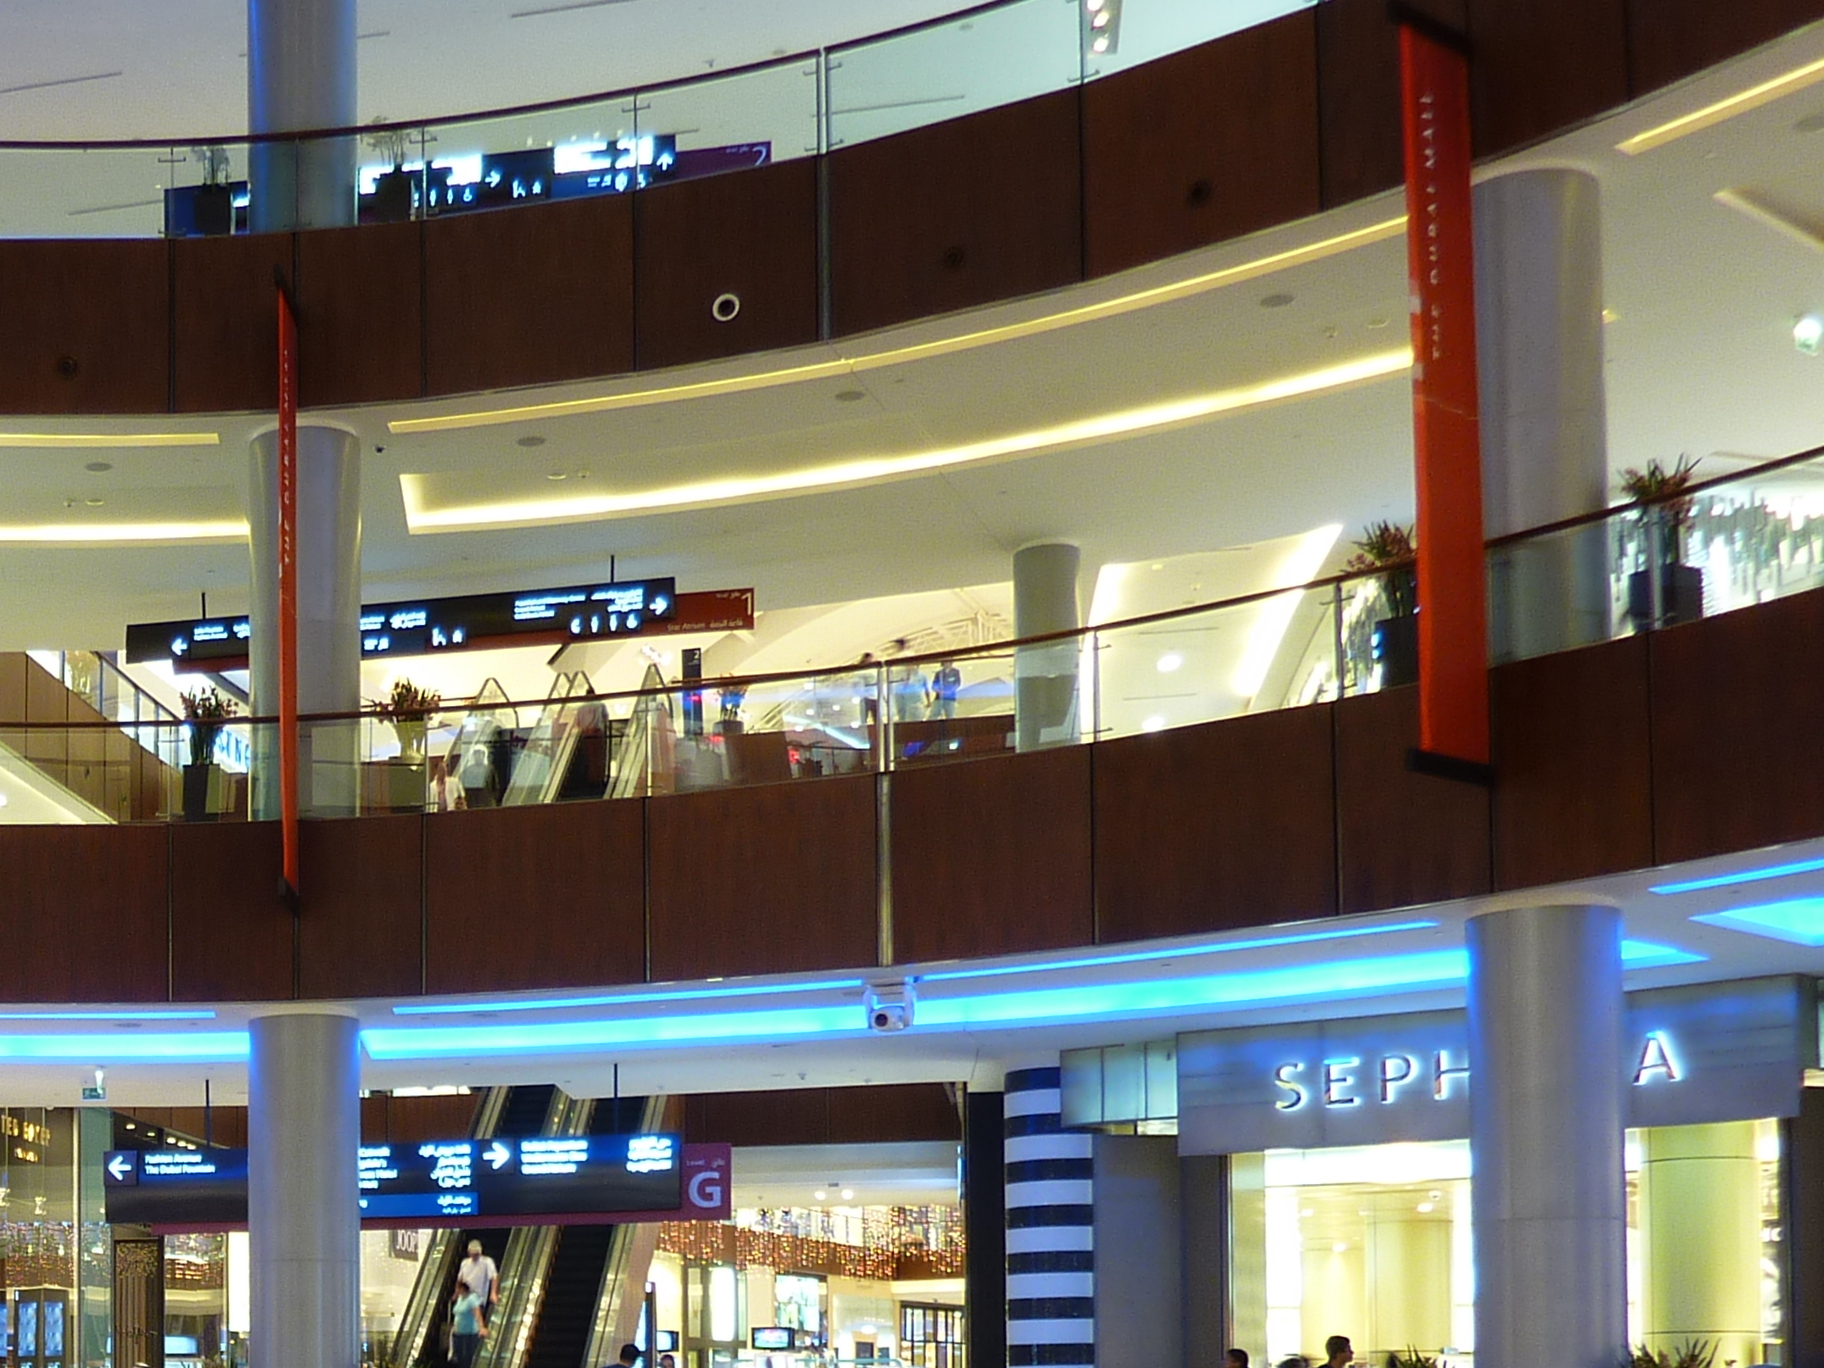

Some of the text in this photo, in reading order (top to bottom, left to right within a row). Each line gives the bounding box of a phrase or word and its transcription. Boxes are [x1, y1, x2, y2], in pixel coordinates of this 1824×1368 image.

[740, 591, 753, 616] 1
[1274, 1028, 1684, 1111] SEPHA
[687, 1171, 722, 1208] G
